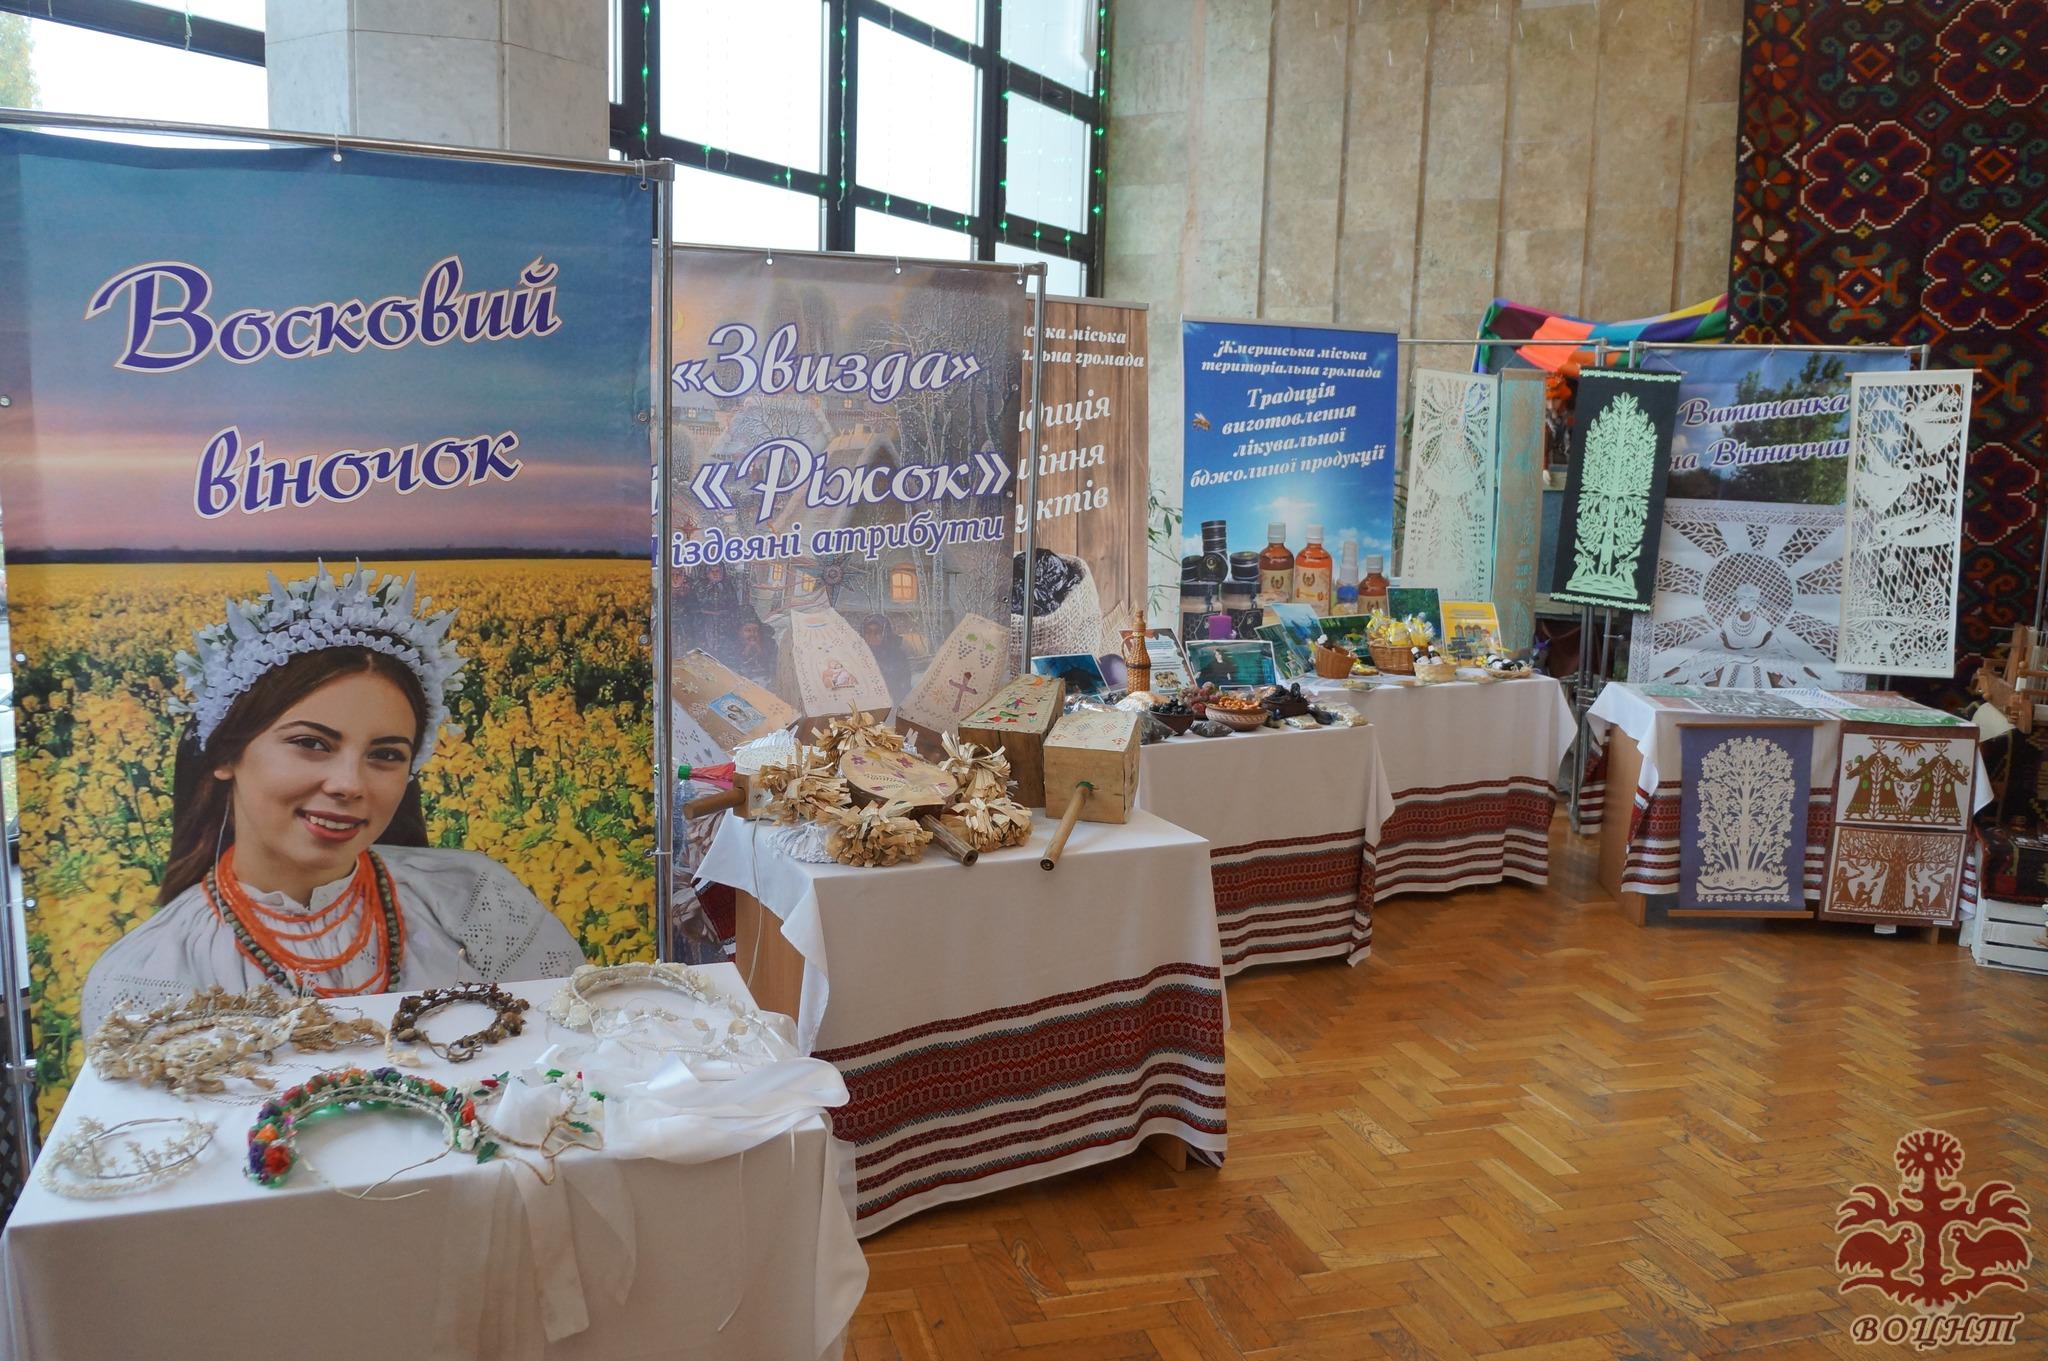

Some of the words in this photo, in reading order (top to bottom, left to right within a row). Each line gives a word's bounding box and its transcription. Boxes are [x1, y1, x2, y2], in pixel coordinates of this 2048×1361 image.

[86, 255, 562, 374] Восковий
[1069, 326, 1127, 344] міська
[1213, 340, 1315, 359] Жмеринська
[1317, 347, 1368, 361] міська
[672, 322, 980, 403] «Звизда»
[1075, 352, 1144, 368] громада
[1201, 360, 1319, 375] територіальна
[1321, 366, 1382, 380] громада
[1246, 382, 1336, 410] Традиція
[1677, 393, 1849, 428] Витинанка
[1221, 404, 1357, 435] виготовлення
[1232, 427, 1347, 458] лікувальної
[194, 425, 523, 519] віночок
[691, 437, 1013, 526] «Ріжок»
[1190, 458, 1297, 488] бджолиної
[1300, 445, 1387, 474] продукції
[651, 522, 802, 568] іздвяні
[812, 510, 1004, 560] атрибути
